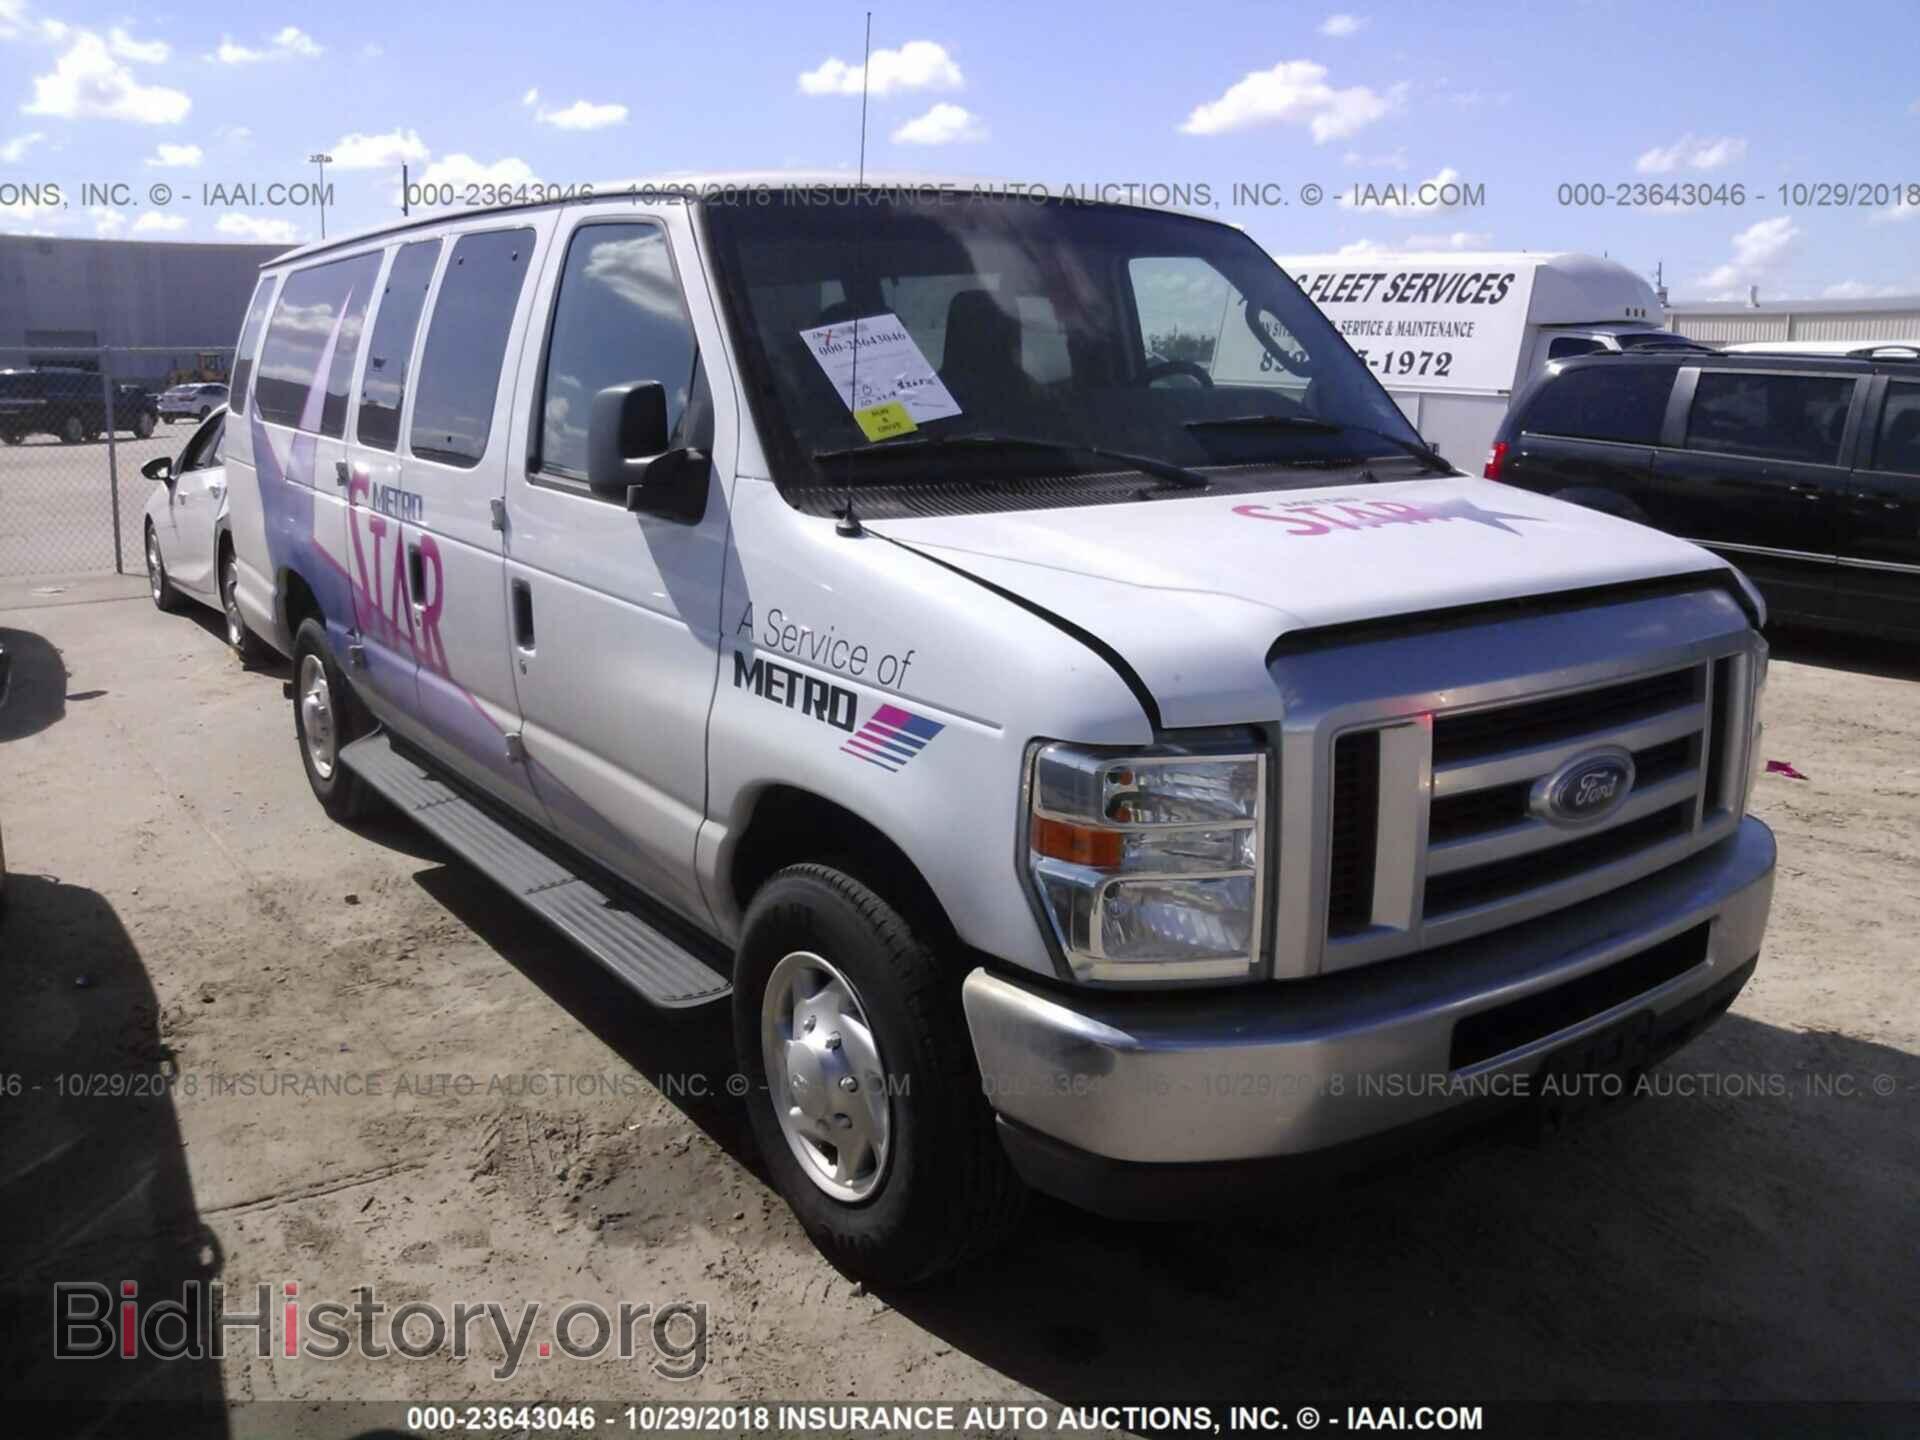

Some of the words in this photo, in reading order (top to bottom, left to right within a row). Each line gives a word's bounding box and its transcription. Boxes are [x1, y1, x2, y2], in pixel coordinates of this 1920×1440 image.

[1308, 273, 1387, 303] FLEET
[1382, 273, 1515, 304] SERVICES
[1341, 320, 1383, 336] SERVICE
[1395, 320, 1475, 338] MAINTENANCE
[373, 482, 423, 521] METRO
[1231, 501, 1453, 536] STAR
[349, 467, 451, 681] STAR
[736, 601, 753, 640] A
[764, 608, 868, 676] Service
[877, 650, 915, 689] of
[734, 650, 858, 733] METRO
[1575, 771, 1618, 806] Ford
